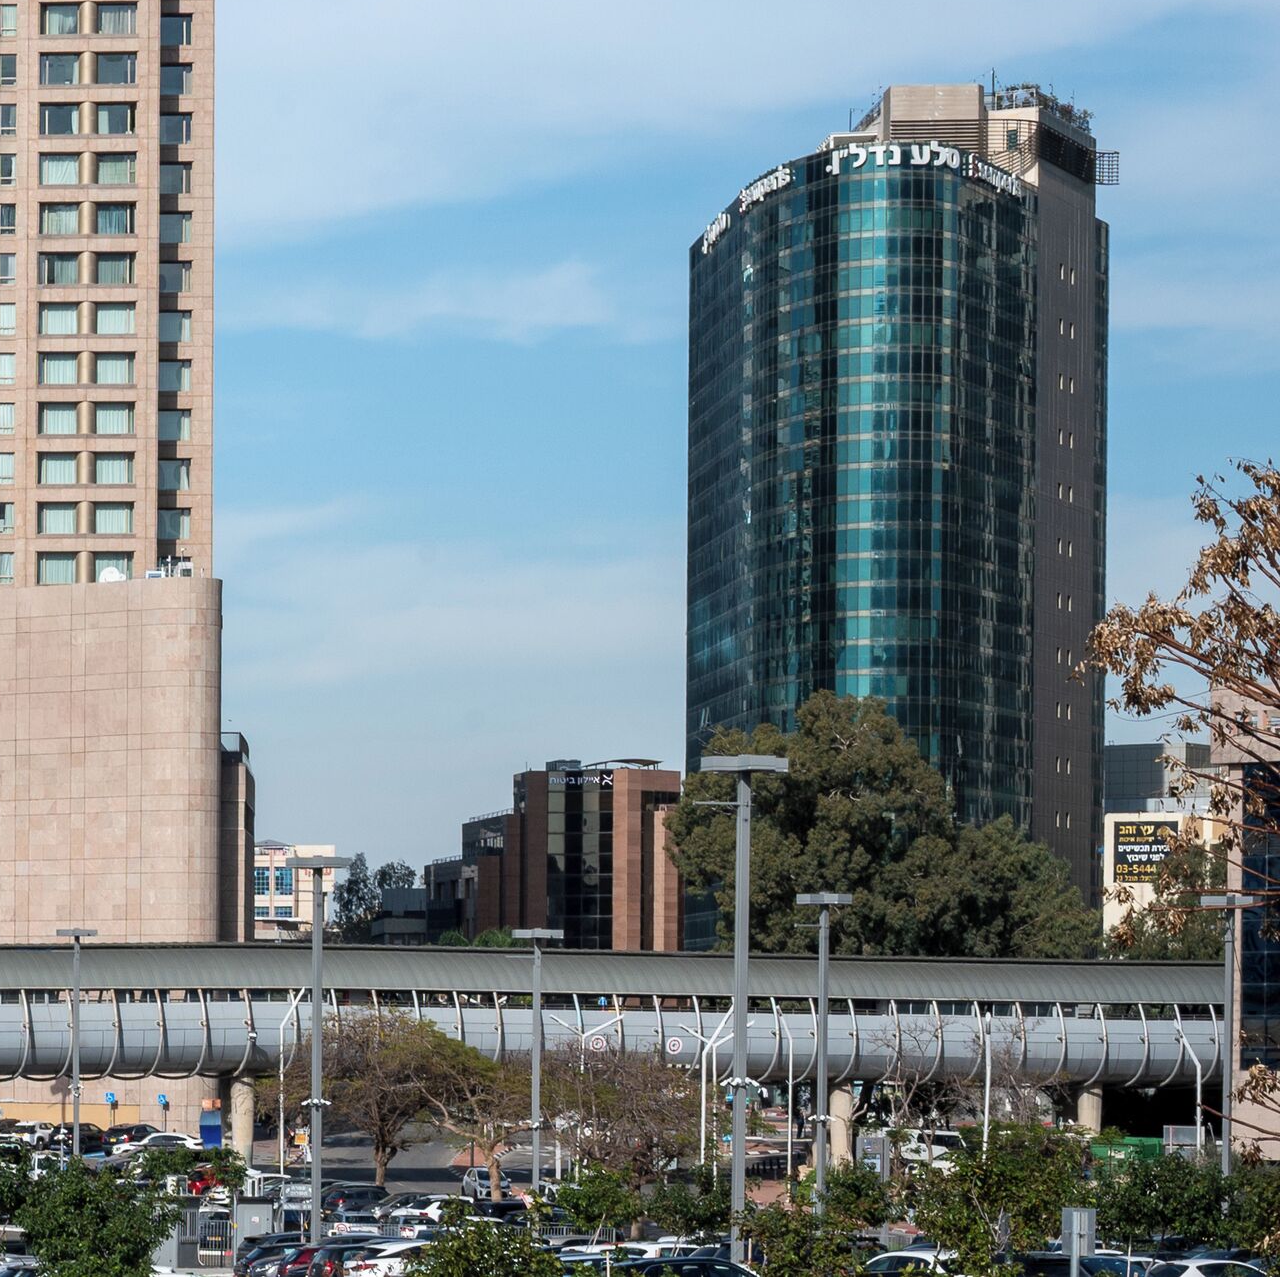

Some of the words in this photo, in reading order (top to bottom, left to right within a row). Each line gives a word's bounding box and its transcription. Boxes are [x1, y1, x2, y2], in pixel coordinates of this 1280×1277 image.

[910, 140, 961, 170] סלע
[1119, 825, 1137, 834] זהב
[1140, 825, 1155, 835] עץ
[1116, 864, 1157, 874] 03-5444
